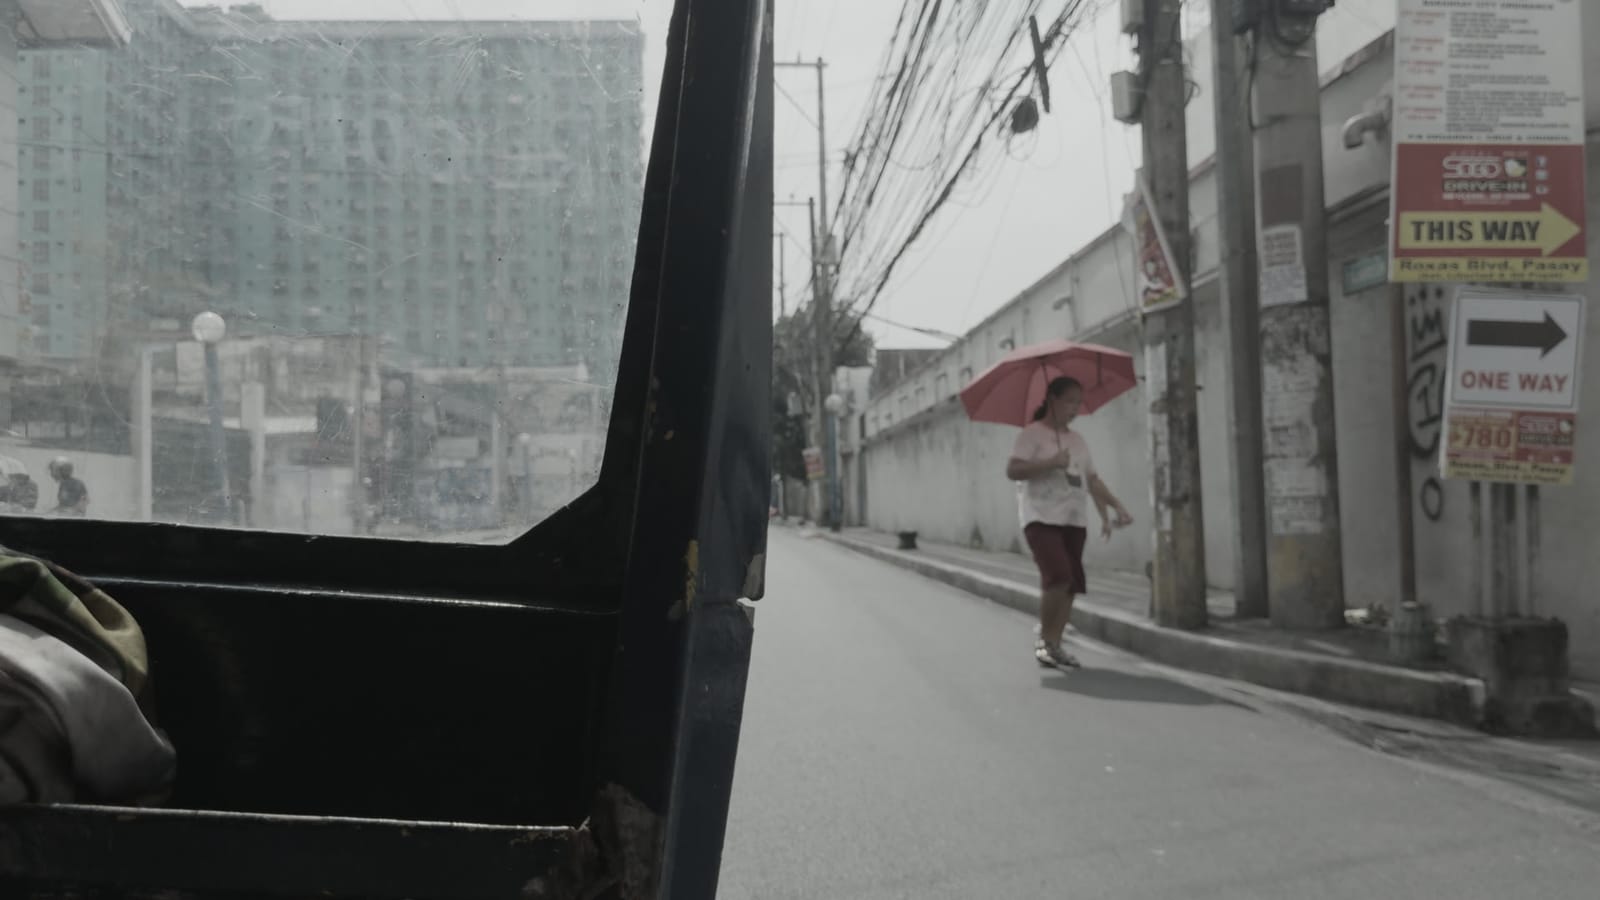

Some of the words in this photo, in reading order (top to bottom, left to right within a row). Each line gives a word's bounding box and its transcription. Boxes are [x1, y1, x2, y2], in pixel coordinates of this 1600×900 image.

[1411, 220, 1473, 241] THIS
[1482, 220, 1540, 241] WAY
[1400, 260, 1460, 270] Roxas
[1522, 260, 1581, 273] Pasay
[1461, 370, 1510, 390] ONE
[1518, 374, 1568, 393] WAY
